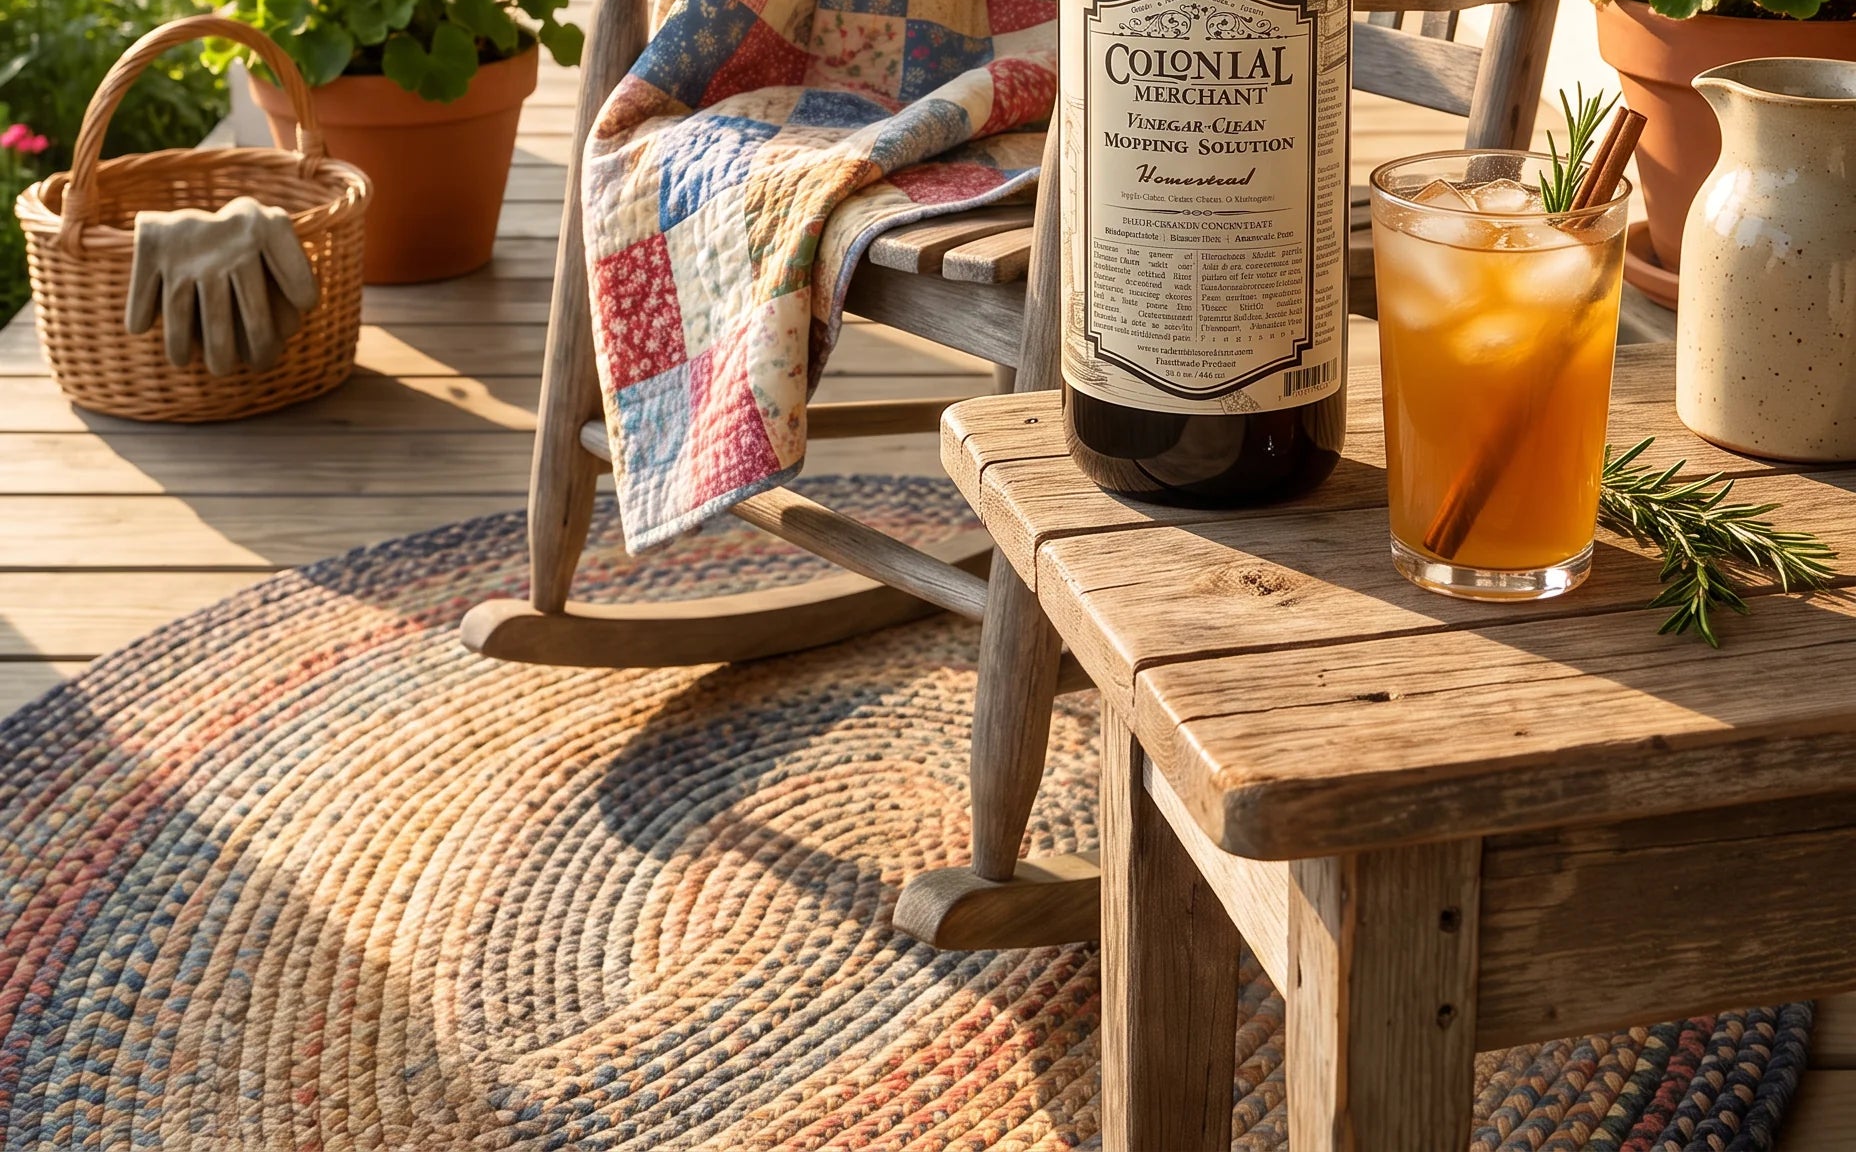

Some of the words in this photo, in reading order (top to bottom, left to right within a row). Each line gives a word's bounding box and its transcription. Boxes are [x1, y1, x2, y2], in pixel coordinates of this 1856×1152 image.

[1105, 43, 1293, 86] COLONIAL
[1133, 85, 1268, 105] MERCHANT
[1104, 132, 1189, 153] MOPPING
[1198, 136, 1295, 156] SOLUTION
[1136, 163, 1256, 186] Homestead
